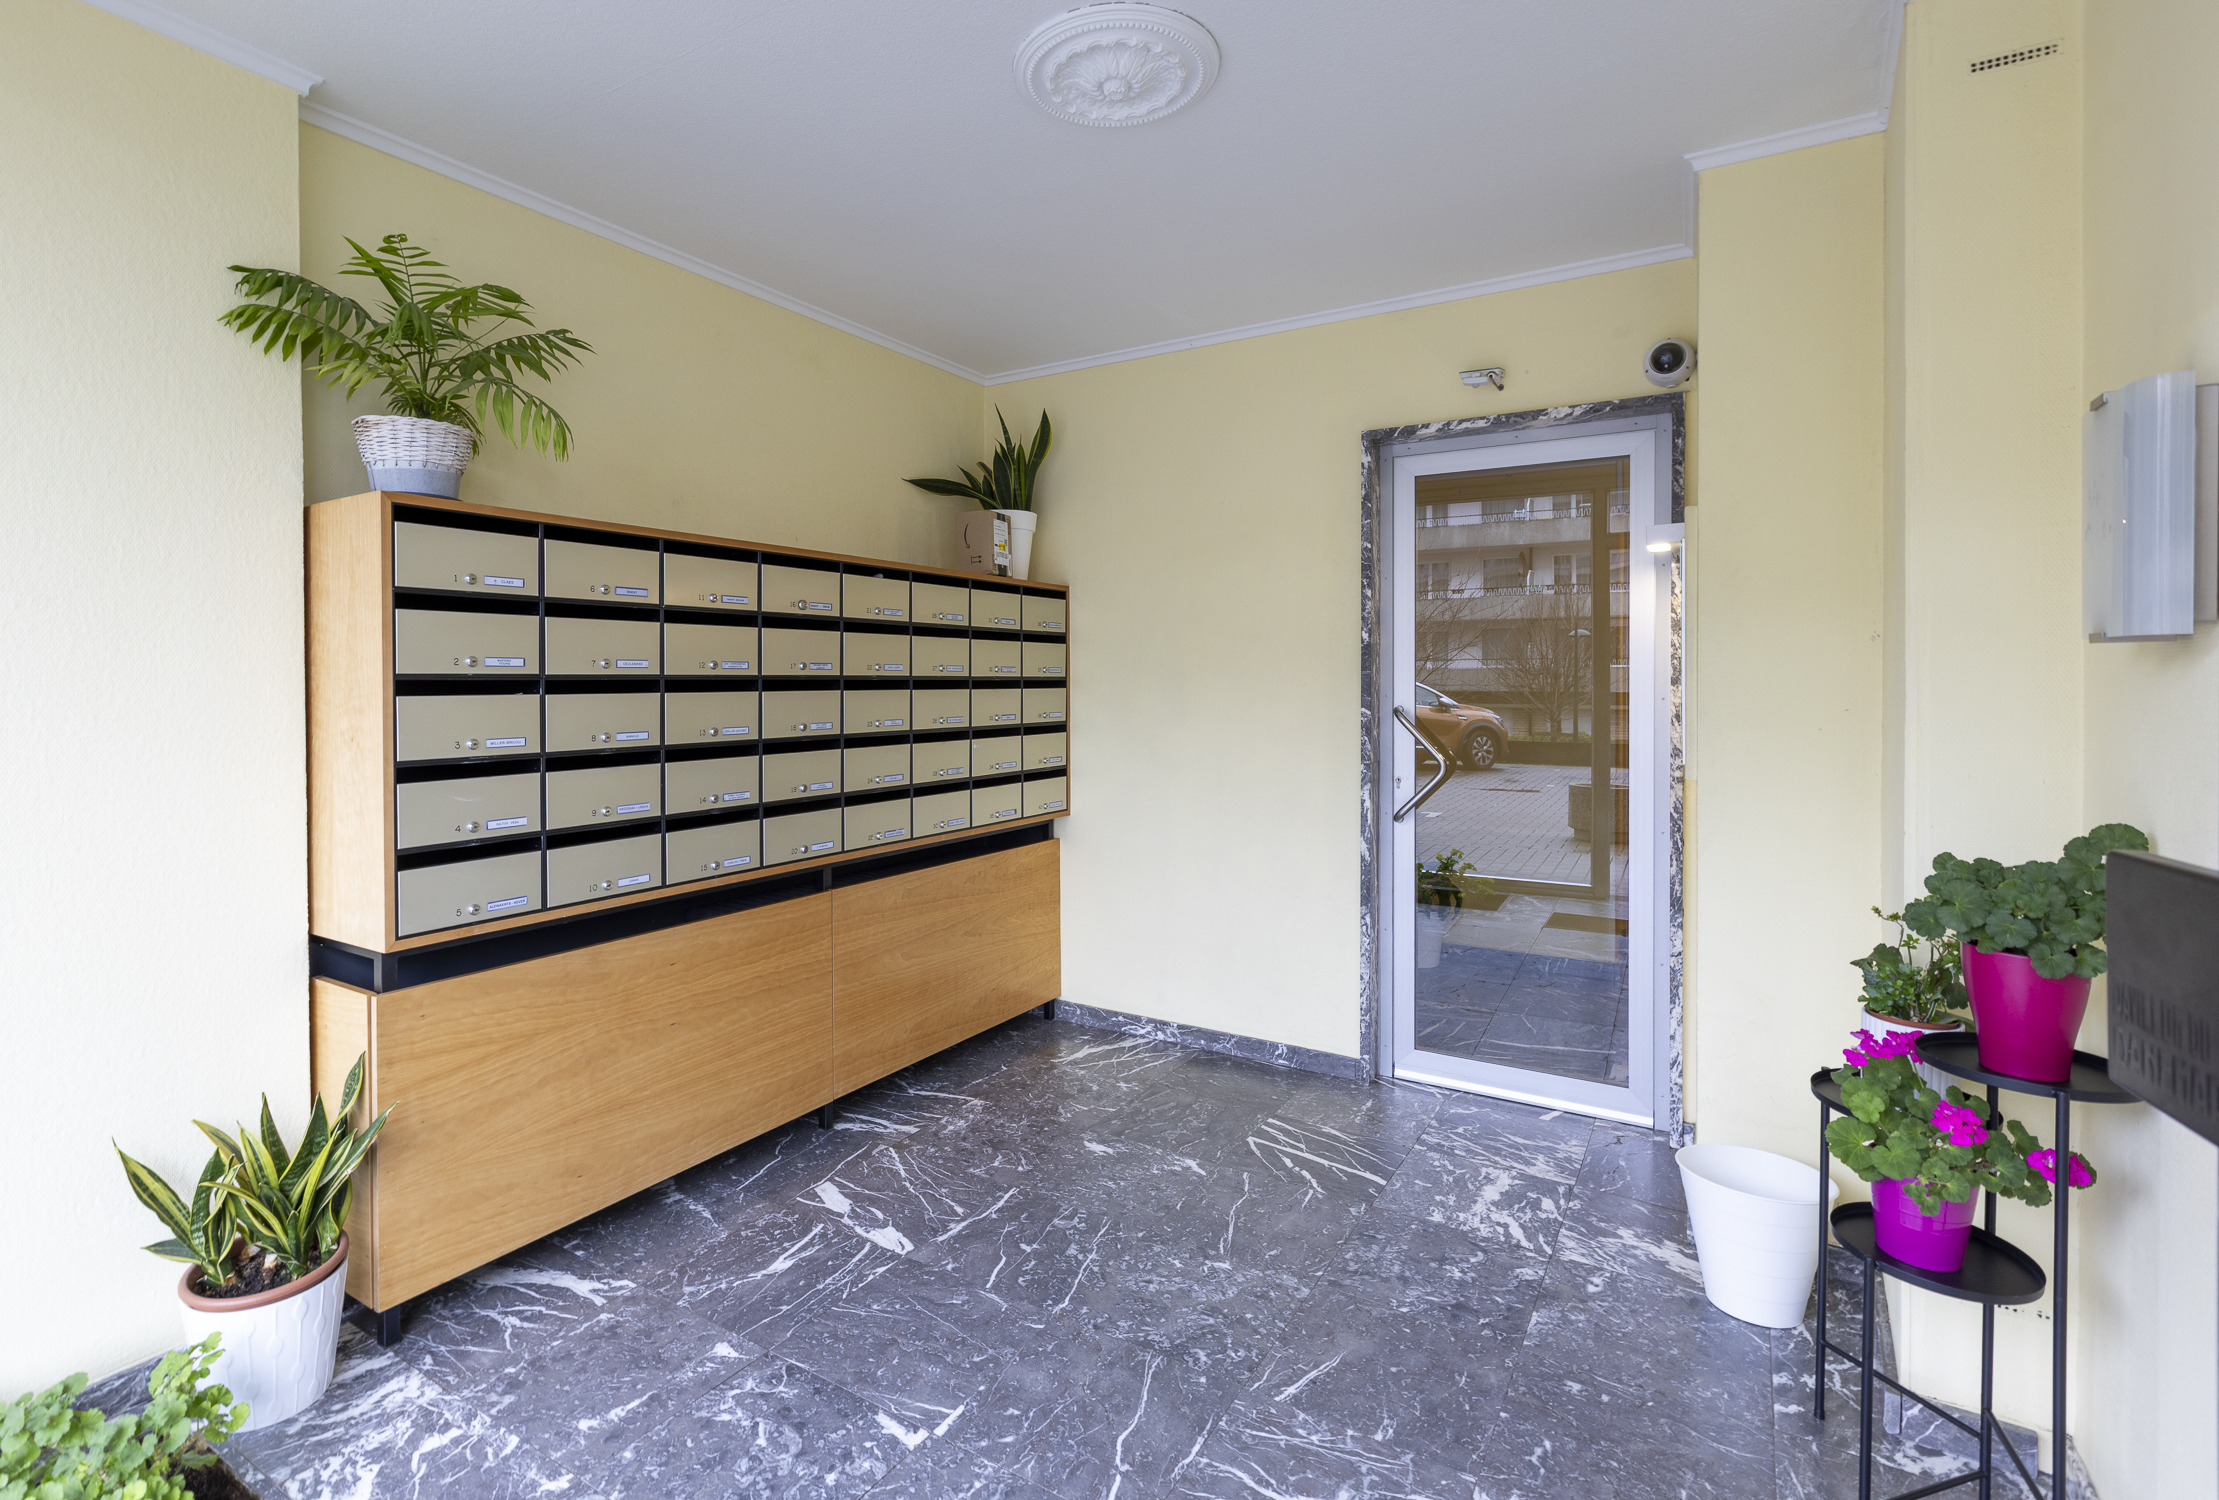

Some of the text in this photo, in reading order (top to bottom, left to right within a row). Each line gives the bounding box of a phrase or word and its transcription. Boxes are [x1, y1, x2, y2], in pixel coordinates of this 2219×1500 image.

[454, 574, 458, 583] 1
[589, 584, 596, 593] 6
[454, 657, 460, 666] 2
[591, 659, 597, 668] 7
[590, 734, 597, 743] 8
[455, 740, 461, 750] 3
[699, 797, 707, 805] 14
[591, 809, 597, 817] 9
[455, 824, 462, 833] 4
[700, 864, 708, 872] 15
[589, 883, 598, 893] 10
[456, 908, 463, 917] 5
